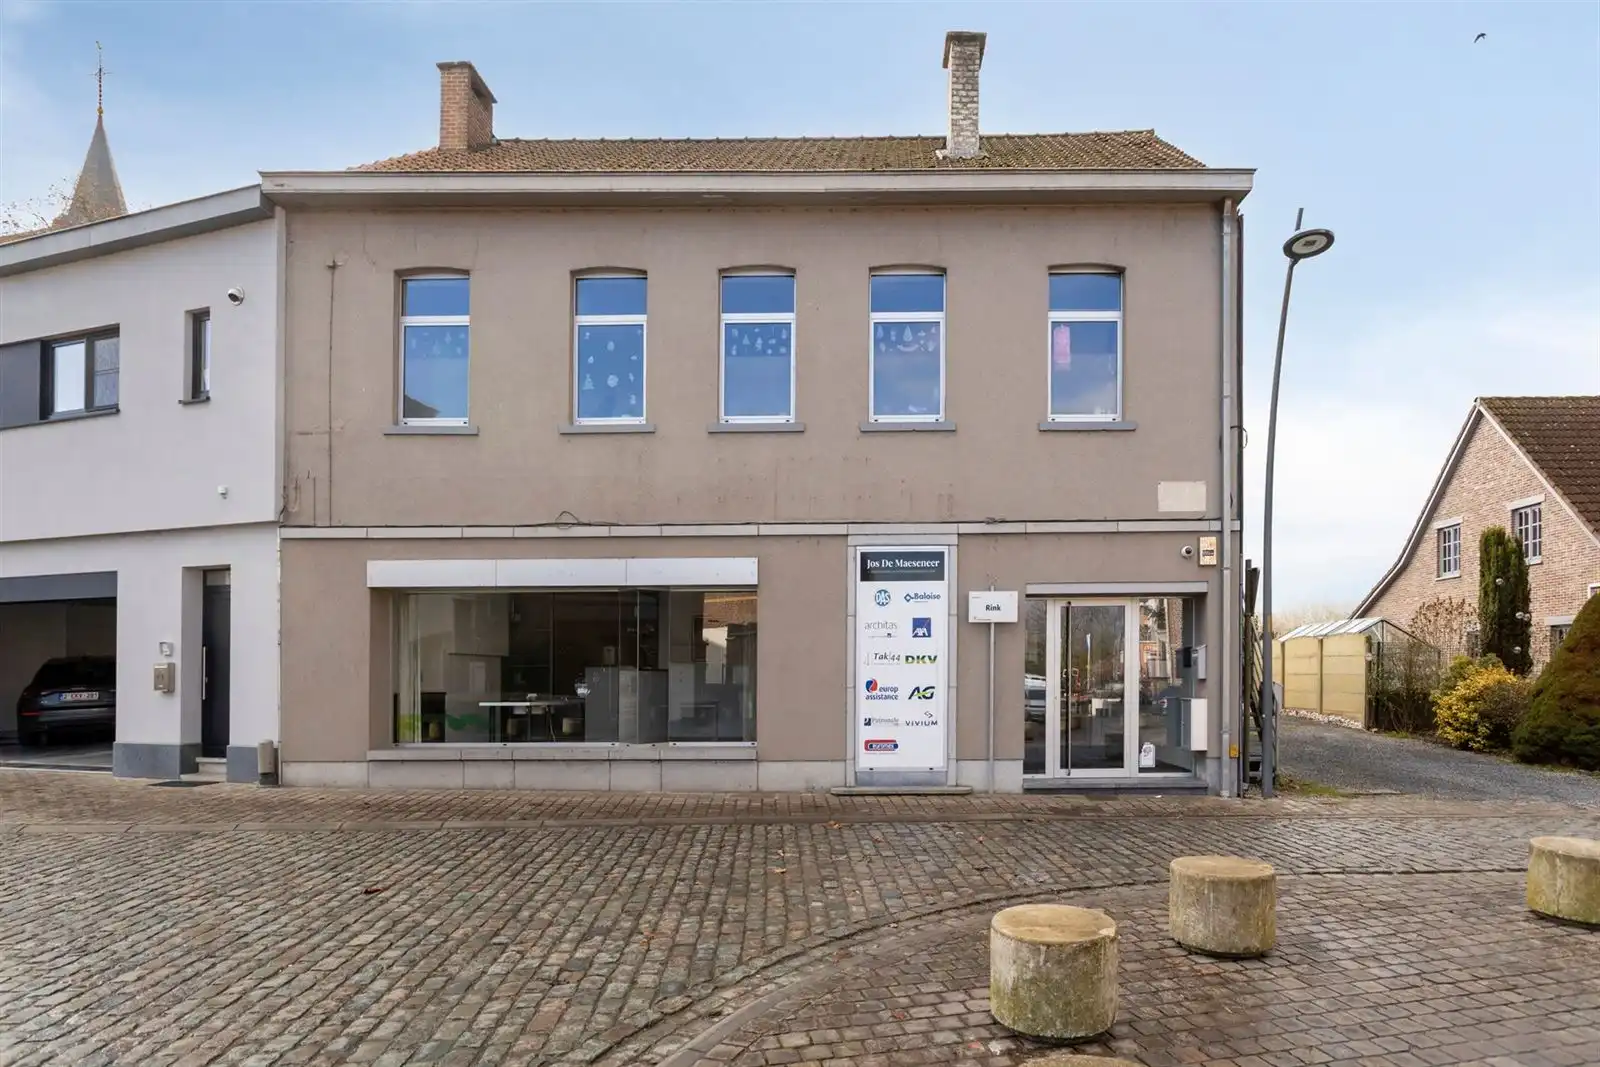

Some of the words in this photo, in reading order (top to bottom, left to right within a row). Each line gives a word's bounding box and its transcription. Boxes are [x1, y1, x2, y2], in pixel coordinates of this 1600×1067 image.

[867, 559, 879, 569] Jos
[882, 559, 893, 567] De
[895, 559, 940, 567] Maeseneer
[913, 592, 941, 600] Baloise
[864, 620, 898, 630] architas
[912, 627, 929, 637] AXA
[873, 652, 889, 660] Tak
[904, 655, 938, 664] DKV
[908, 686, 935, 700] AG
